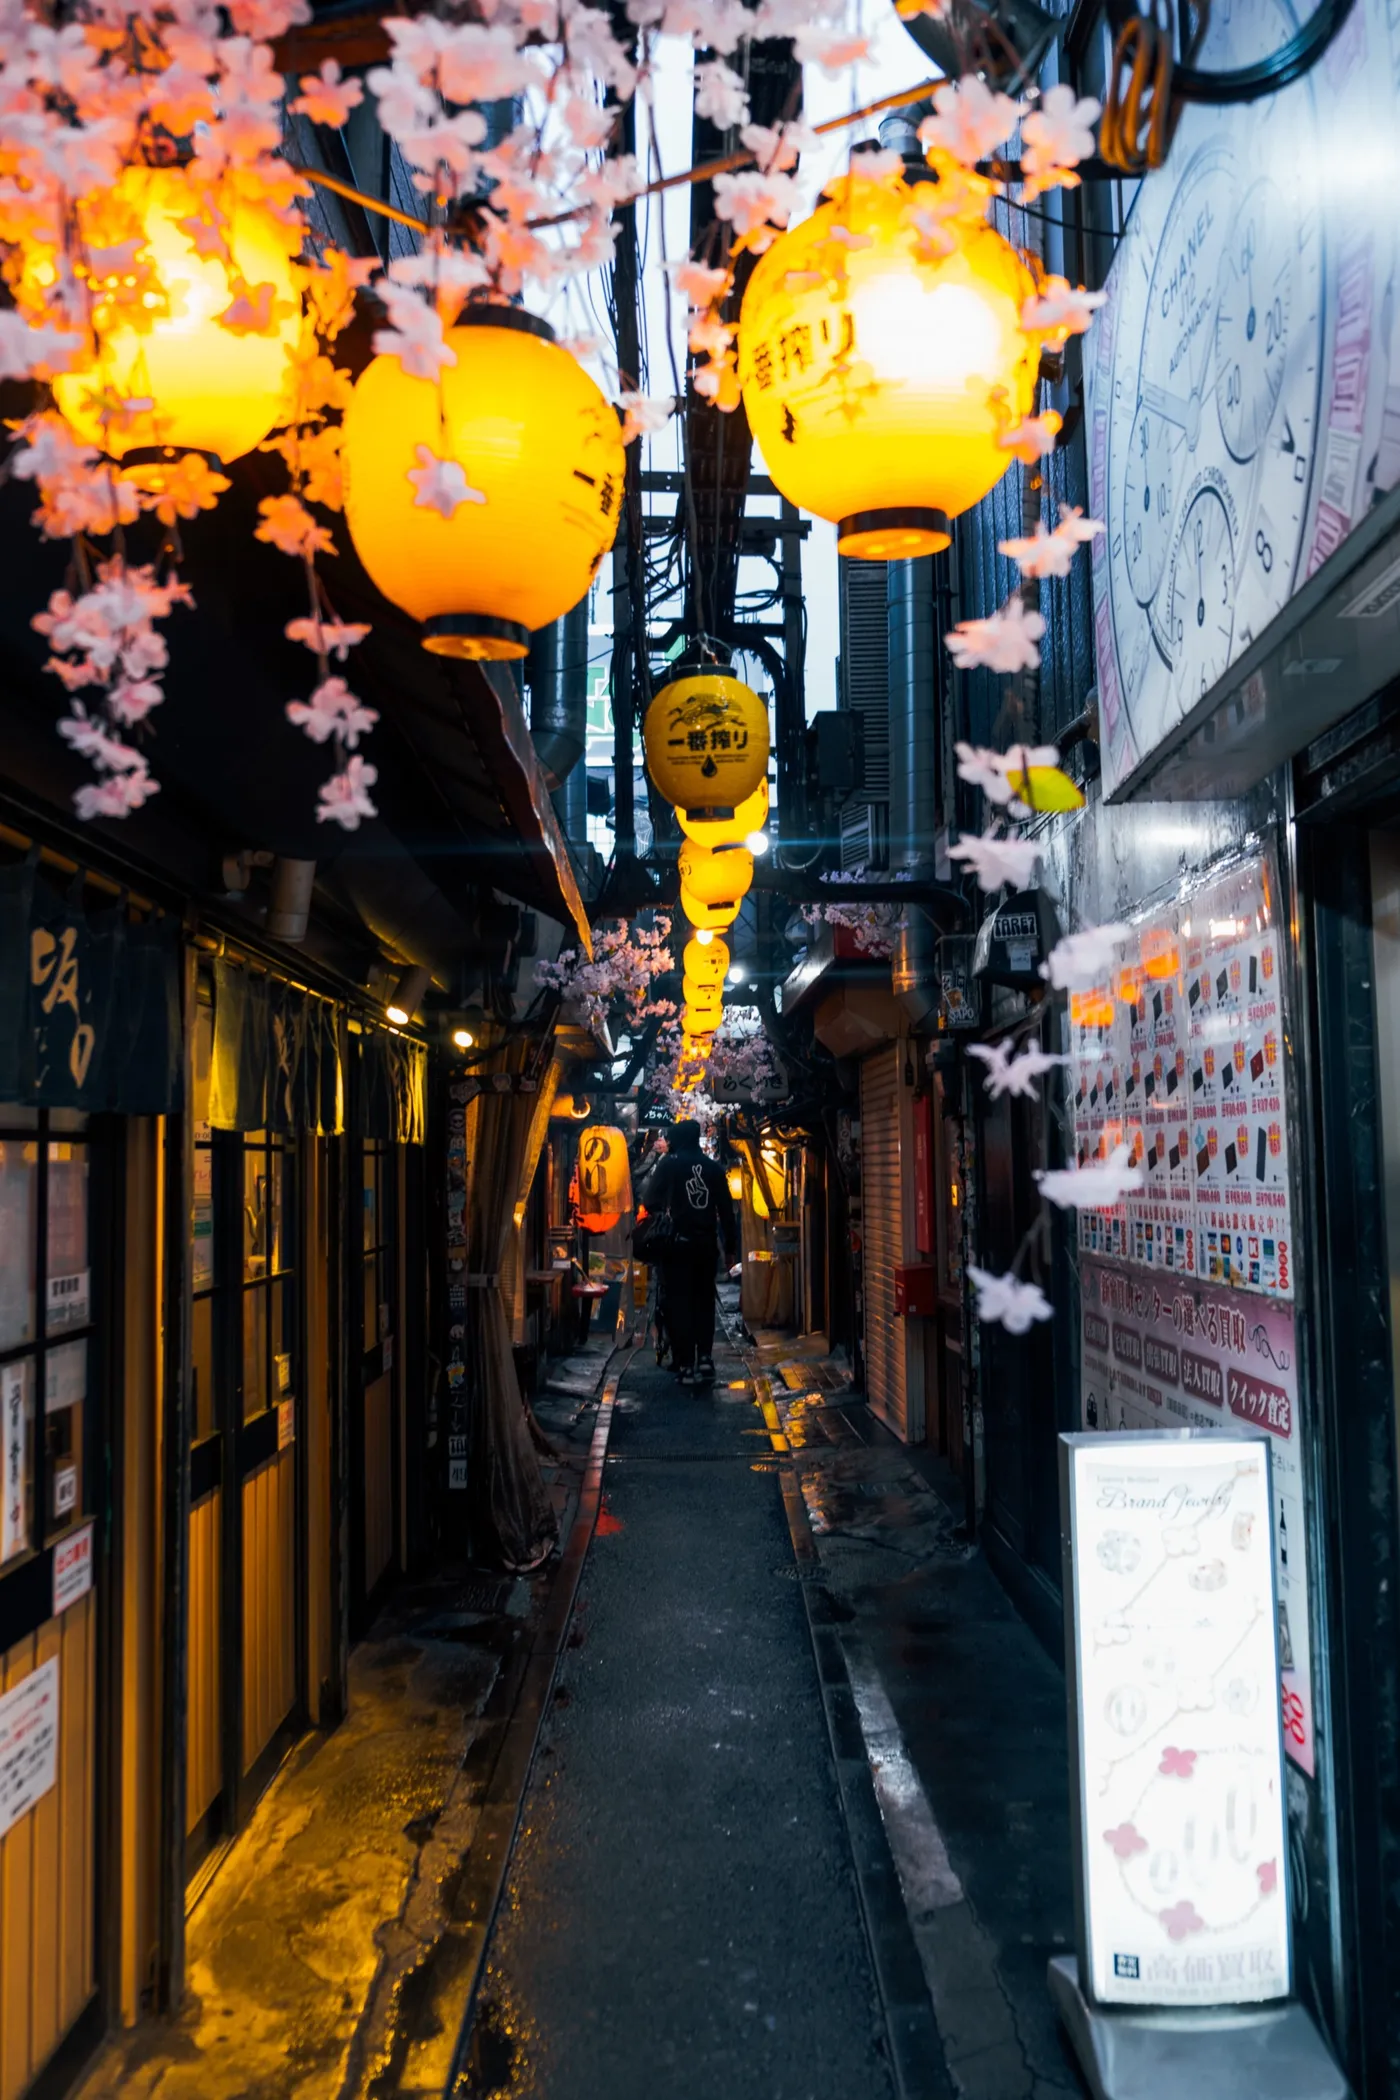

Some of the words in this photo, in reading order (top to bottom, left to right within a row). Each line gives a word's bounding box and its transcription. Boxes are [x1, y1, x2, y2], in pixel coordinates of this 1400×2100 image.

[1162, 200, 1214, 318] CHANEL
[1255, 529, 1273, 574] 8
[667, 729, 749, 752] 一番搾り
[1230, 1376, 1290, 1432] クイック査定
[1096, 1484, 1168, 1511] Brand
